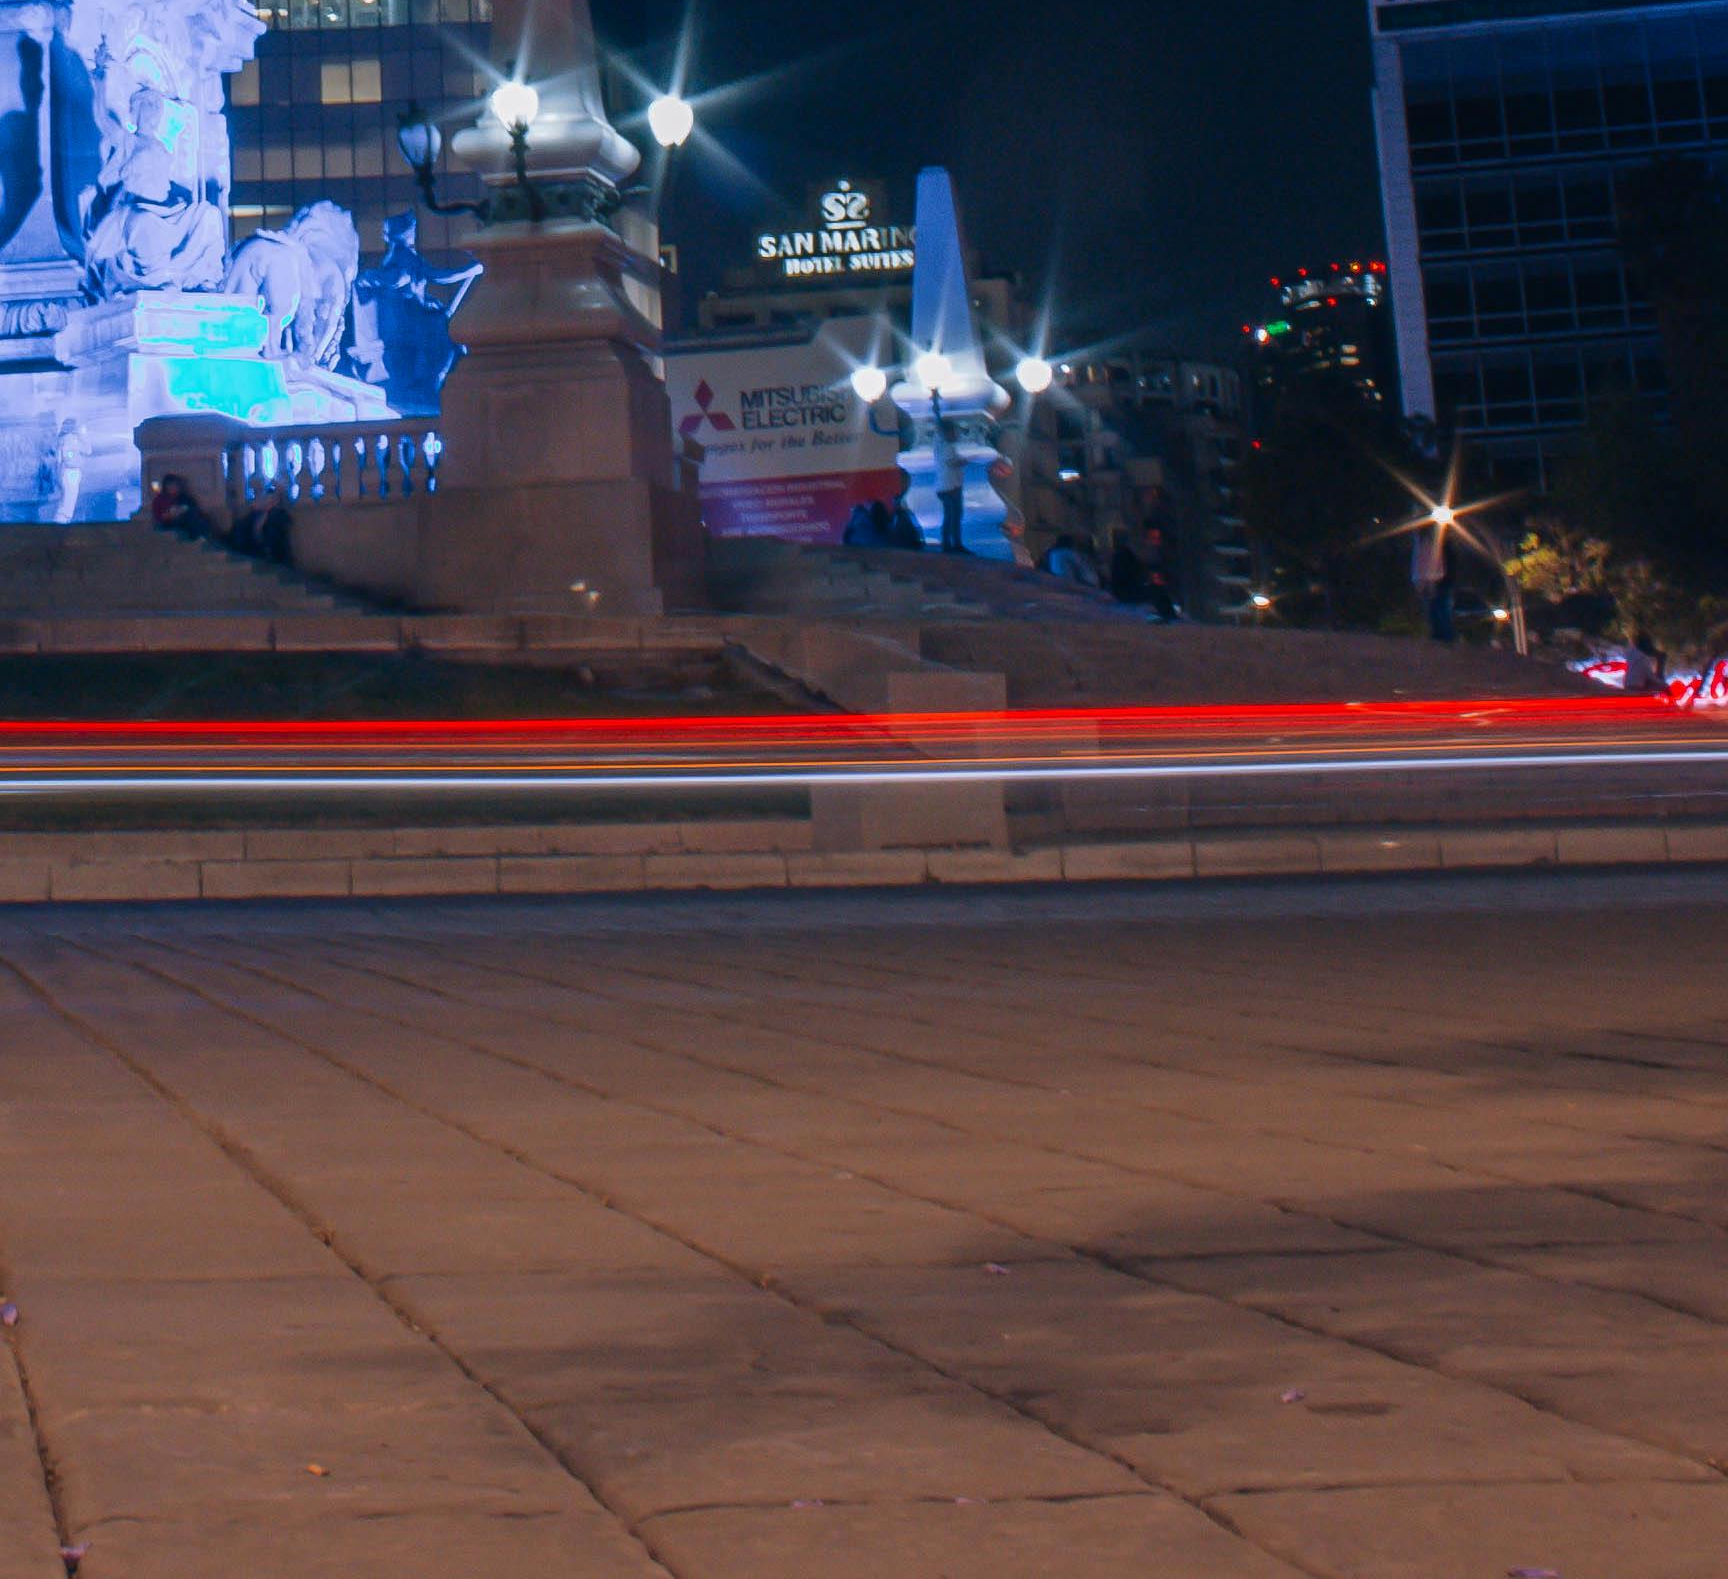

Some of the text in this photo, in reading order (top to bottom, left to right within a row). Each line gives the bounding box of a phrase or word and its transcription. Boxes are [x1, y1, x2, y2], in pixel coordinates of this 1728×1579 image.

[758, 231, 815, 259] SAN
[784, 249, 916, 277] HOTEL SUITES
[742, 404, 846, 430] ELECTRIC
